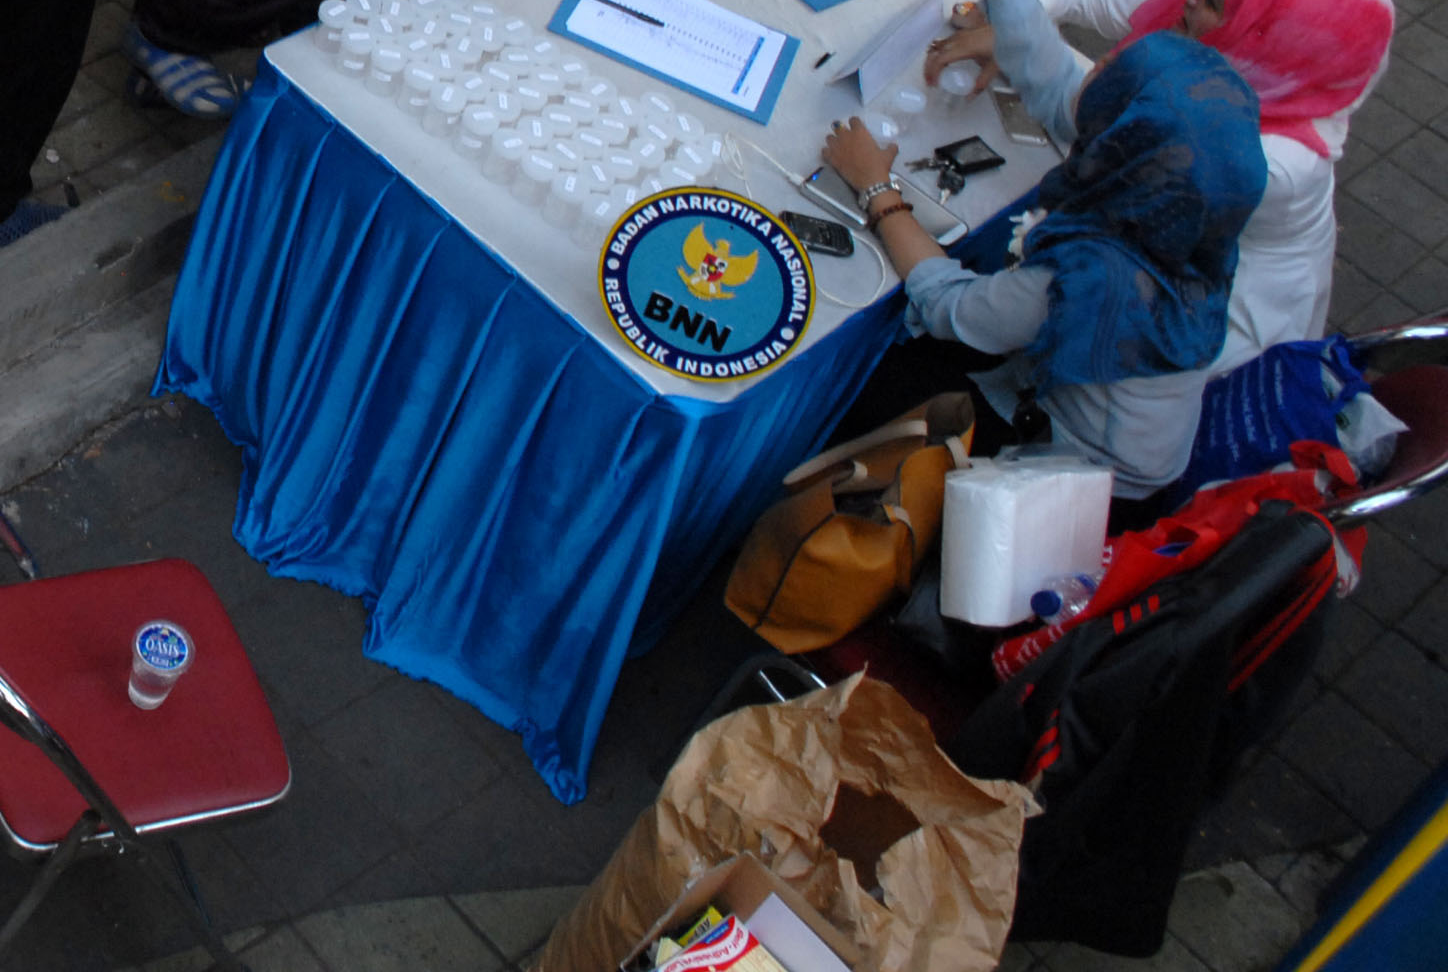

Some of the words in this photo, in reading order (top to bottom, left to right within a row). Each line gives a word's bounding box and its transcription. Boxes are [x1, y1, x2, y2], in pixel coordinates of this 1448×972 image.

[610, 204, 660, 256] BADAN
[658, 195, 773, 238] NARKOTIKA
[770, 230, 807, 323] NASIONAL
[604, 276, 670, 364] REPUBLIK
[676, 339, 788, 377] INDONESIA
[643, 291, 733, 353] BNN
[145, 636, 180, 657] OASIS
